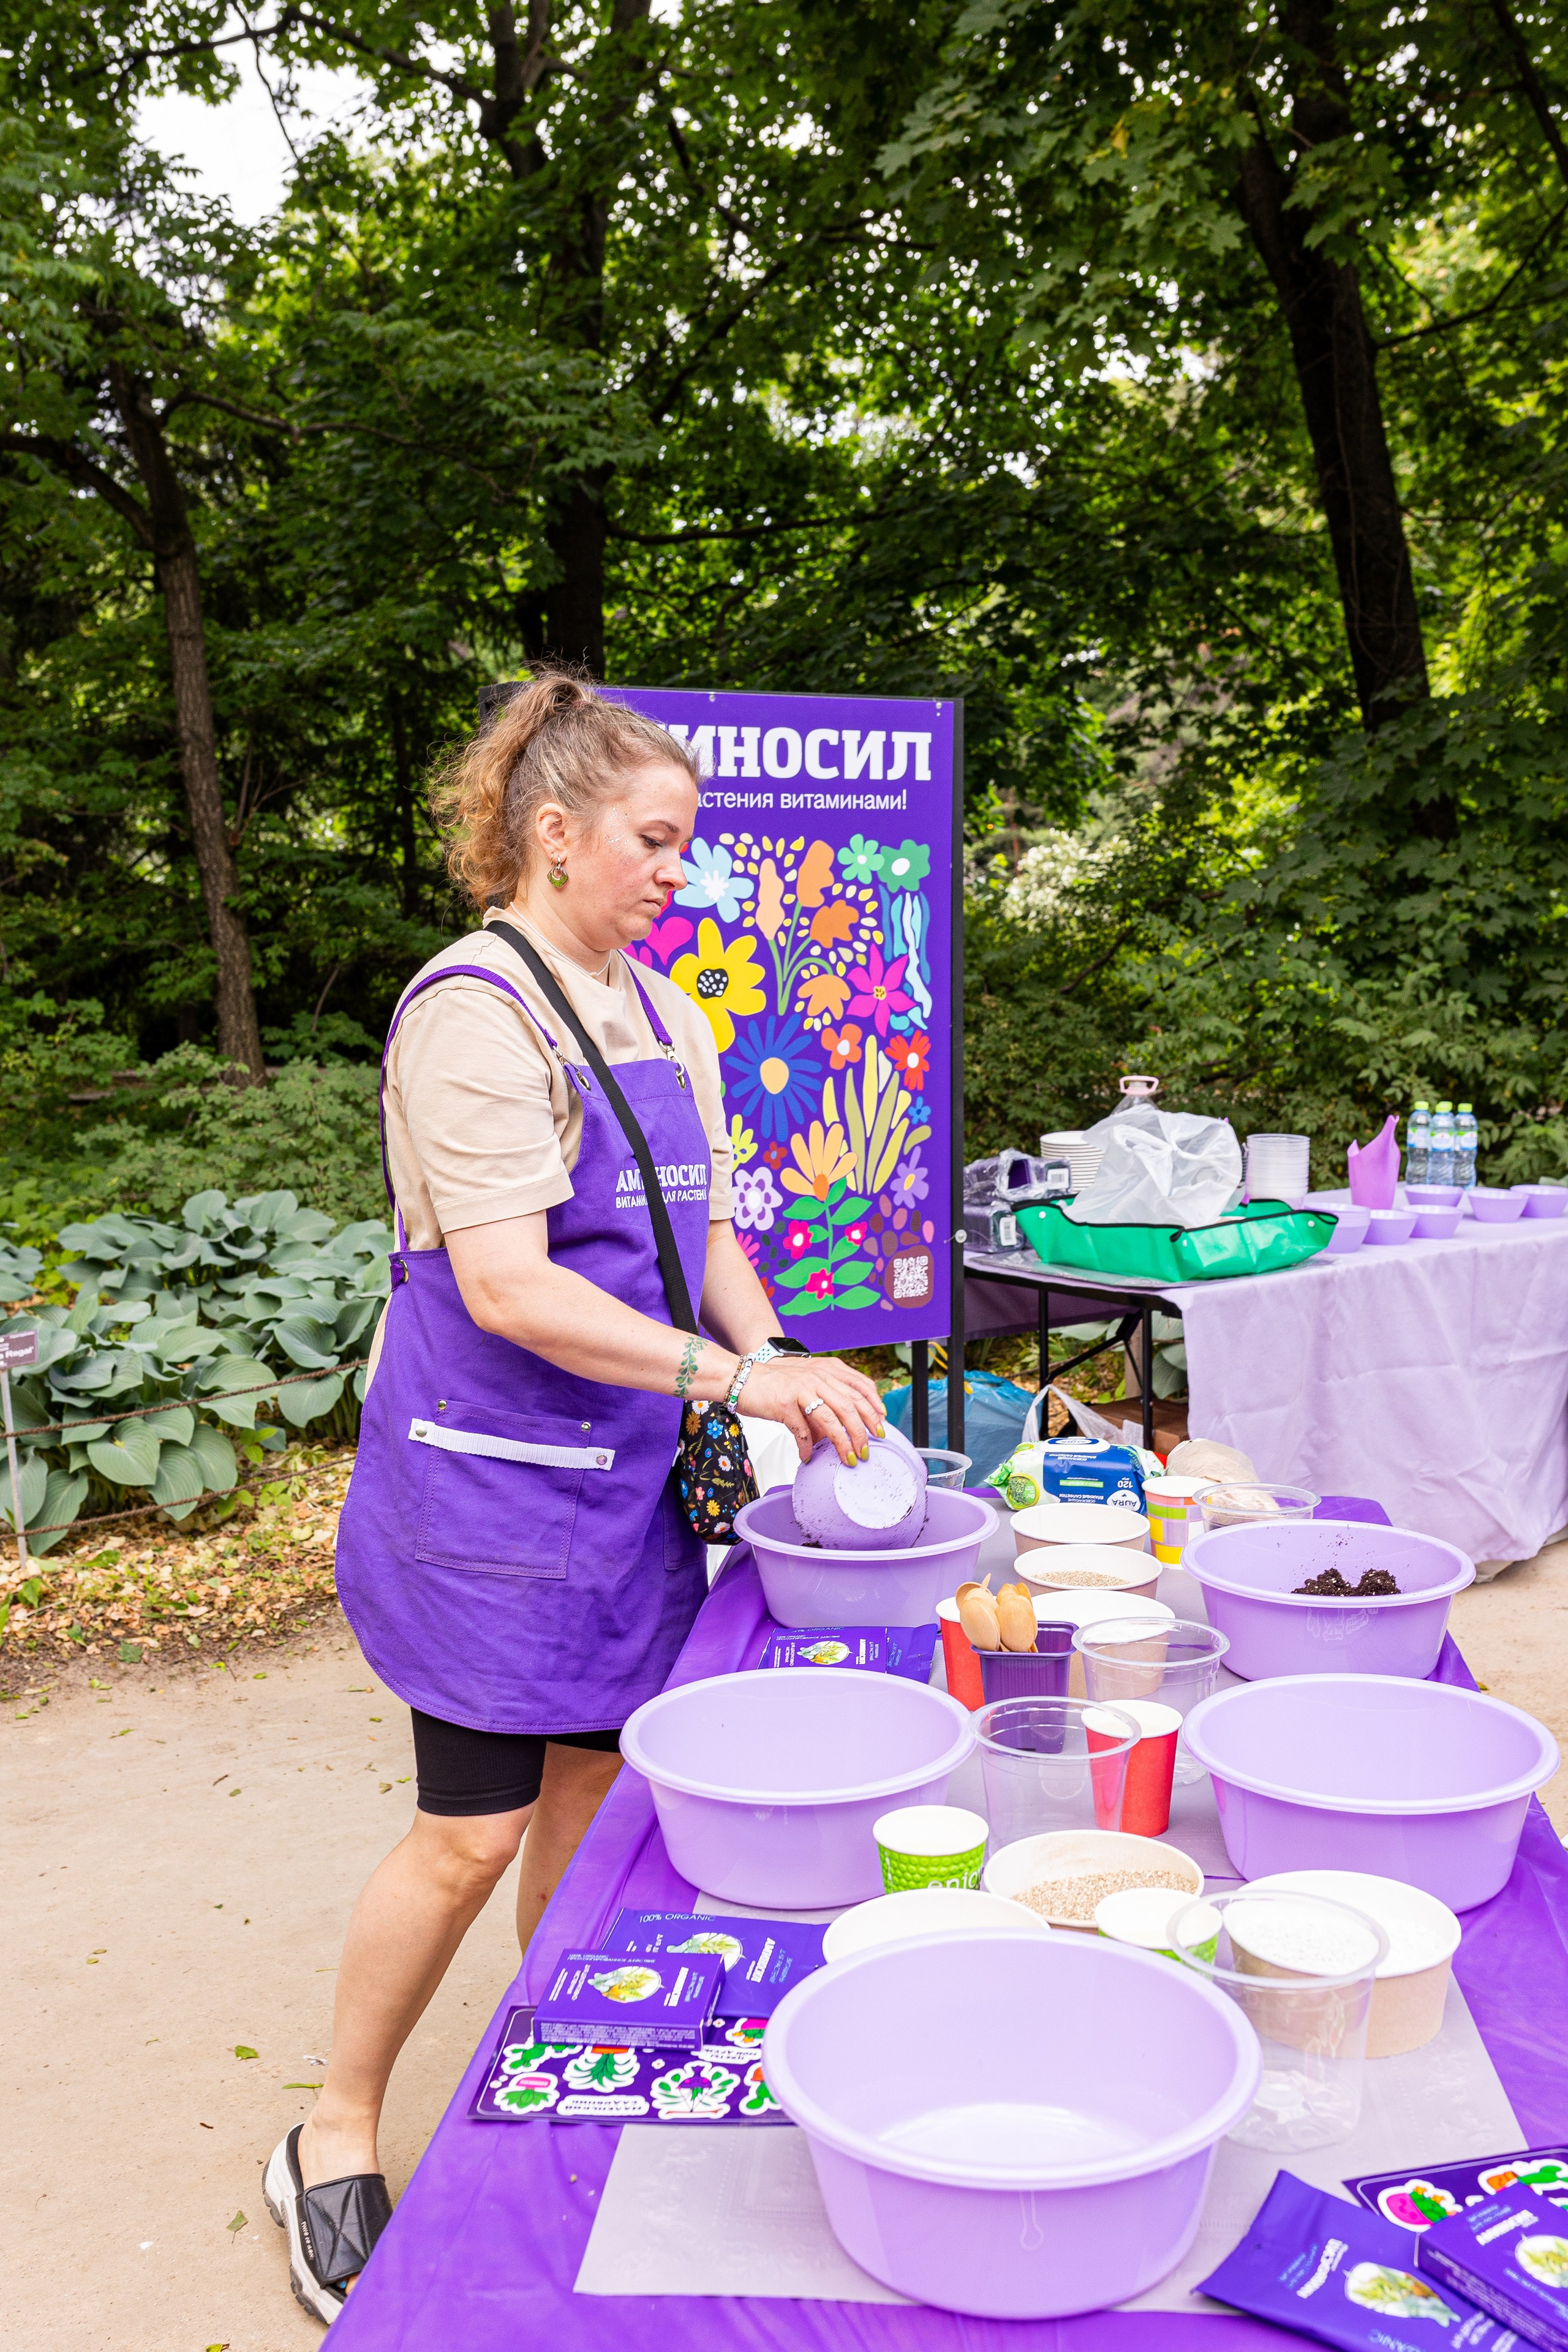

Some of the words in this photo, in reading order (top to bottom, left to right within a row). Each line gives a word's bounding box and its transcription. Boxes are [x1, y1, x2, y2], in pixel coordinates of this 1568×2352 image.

[657, 724, 932, 780] ИНОСИЛ
[780, 789, 907, 810] витаминами!
[616, 1164, 707, 1193] АМНОСИЛ
[616, 1194, 649, 1208] ВИТАМИ
[1117, 1480, 1133, 1488] 120
[1112, 1499, 1137, 1507] AURA
[639, 1913, 662, 1923] 100%
[665, 1913, 717, 1922] ORGANIC
